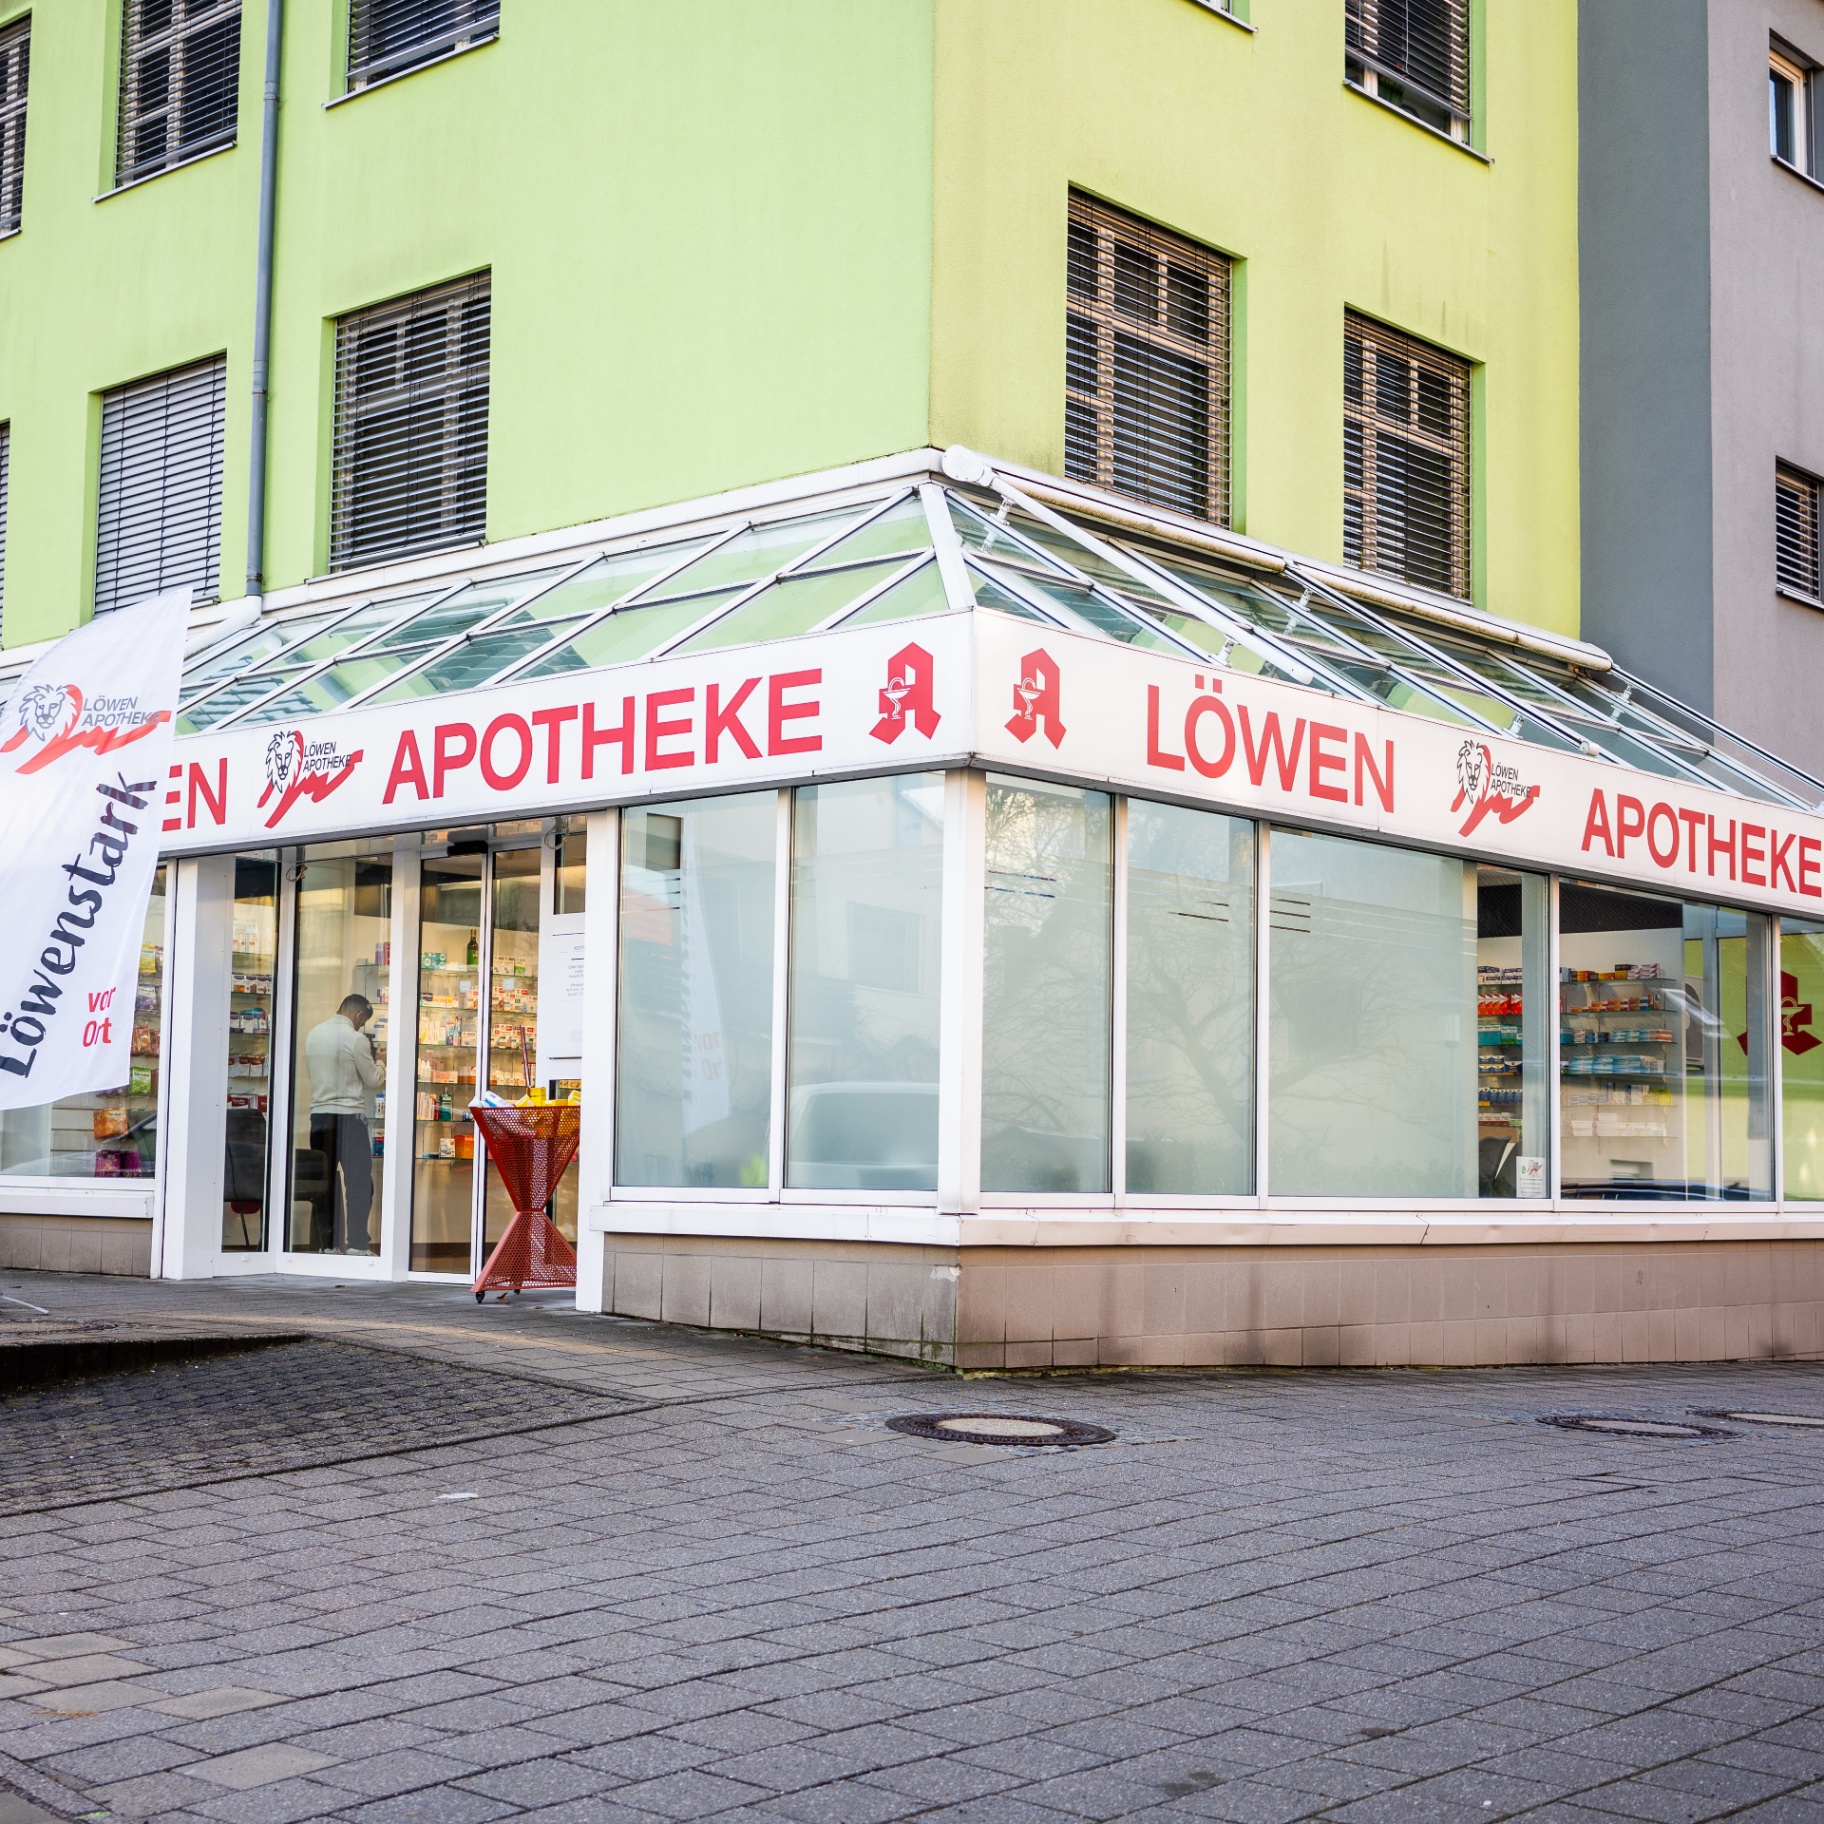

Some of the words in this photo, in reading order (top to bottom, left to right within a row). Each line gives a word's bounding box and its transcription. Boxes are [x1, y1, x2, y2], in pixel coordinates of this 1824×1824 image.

[83, 695, 138, 712] LÖWEN
[81, 711, 161, 726] APOTHEKE
[382, 668, 823, 804] APOTHEKE
[303, 741, 337, 758] LÖWEN
[303, 754, 352, 772] APOTHEKE
[1490, 762, 1519, 781] LÖWEN
[1147, 674, 1395, 813] LÖWEN
[1581, 788, 1823, 898] APOTHEKE
[1490, 779, 1532, 798] APOTHEKE
[0, 771, 157, 1078] Löwenstark
[88, 987, 117, 1013] vor
[82, 1017, 112, 1048] Ort
